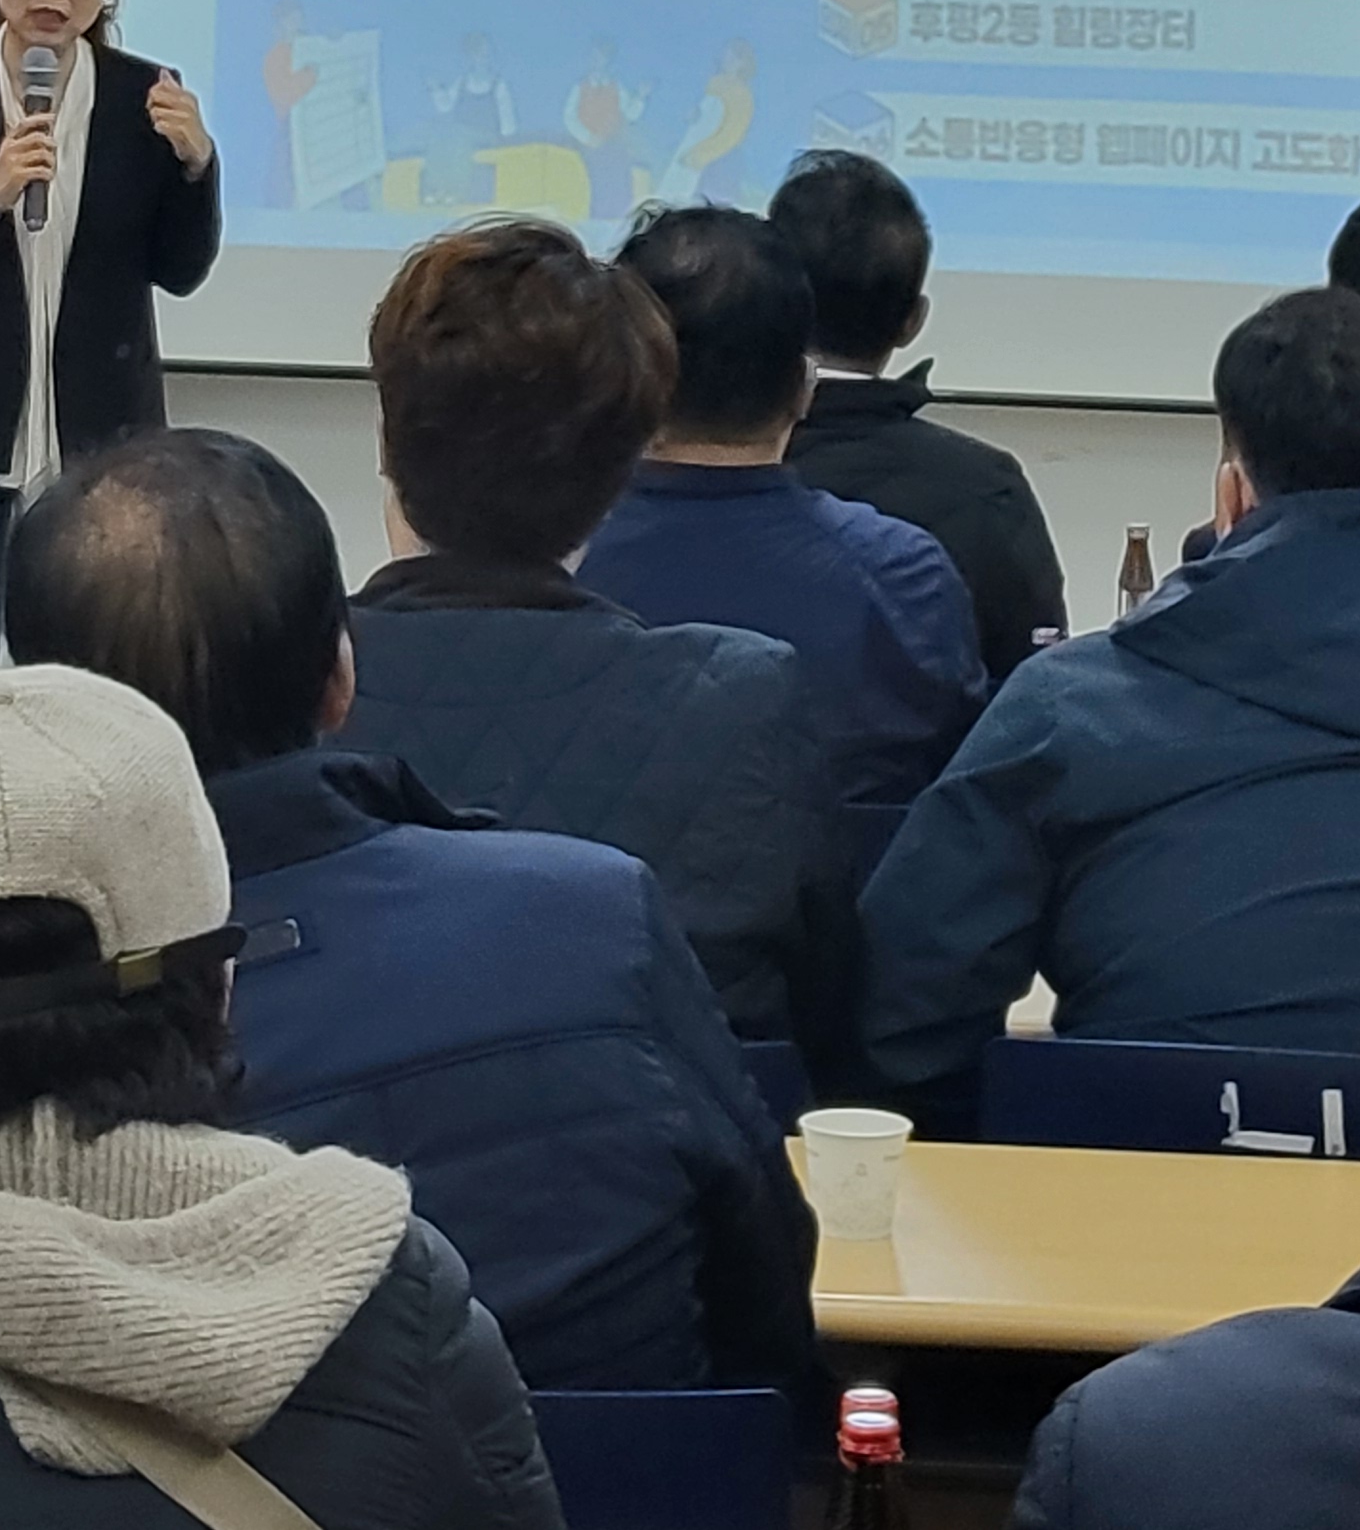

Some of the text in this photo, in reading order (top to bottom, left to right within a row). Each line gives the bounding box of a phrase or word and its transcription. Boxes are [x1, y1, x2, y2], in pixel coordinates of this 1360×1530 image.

[908, 0, 1197, 51] 후평2동 힐링장터
[903, 116, 1085, 164] 소통반응형
[1096, 123, 1241, 171] 웹페이지
